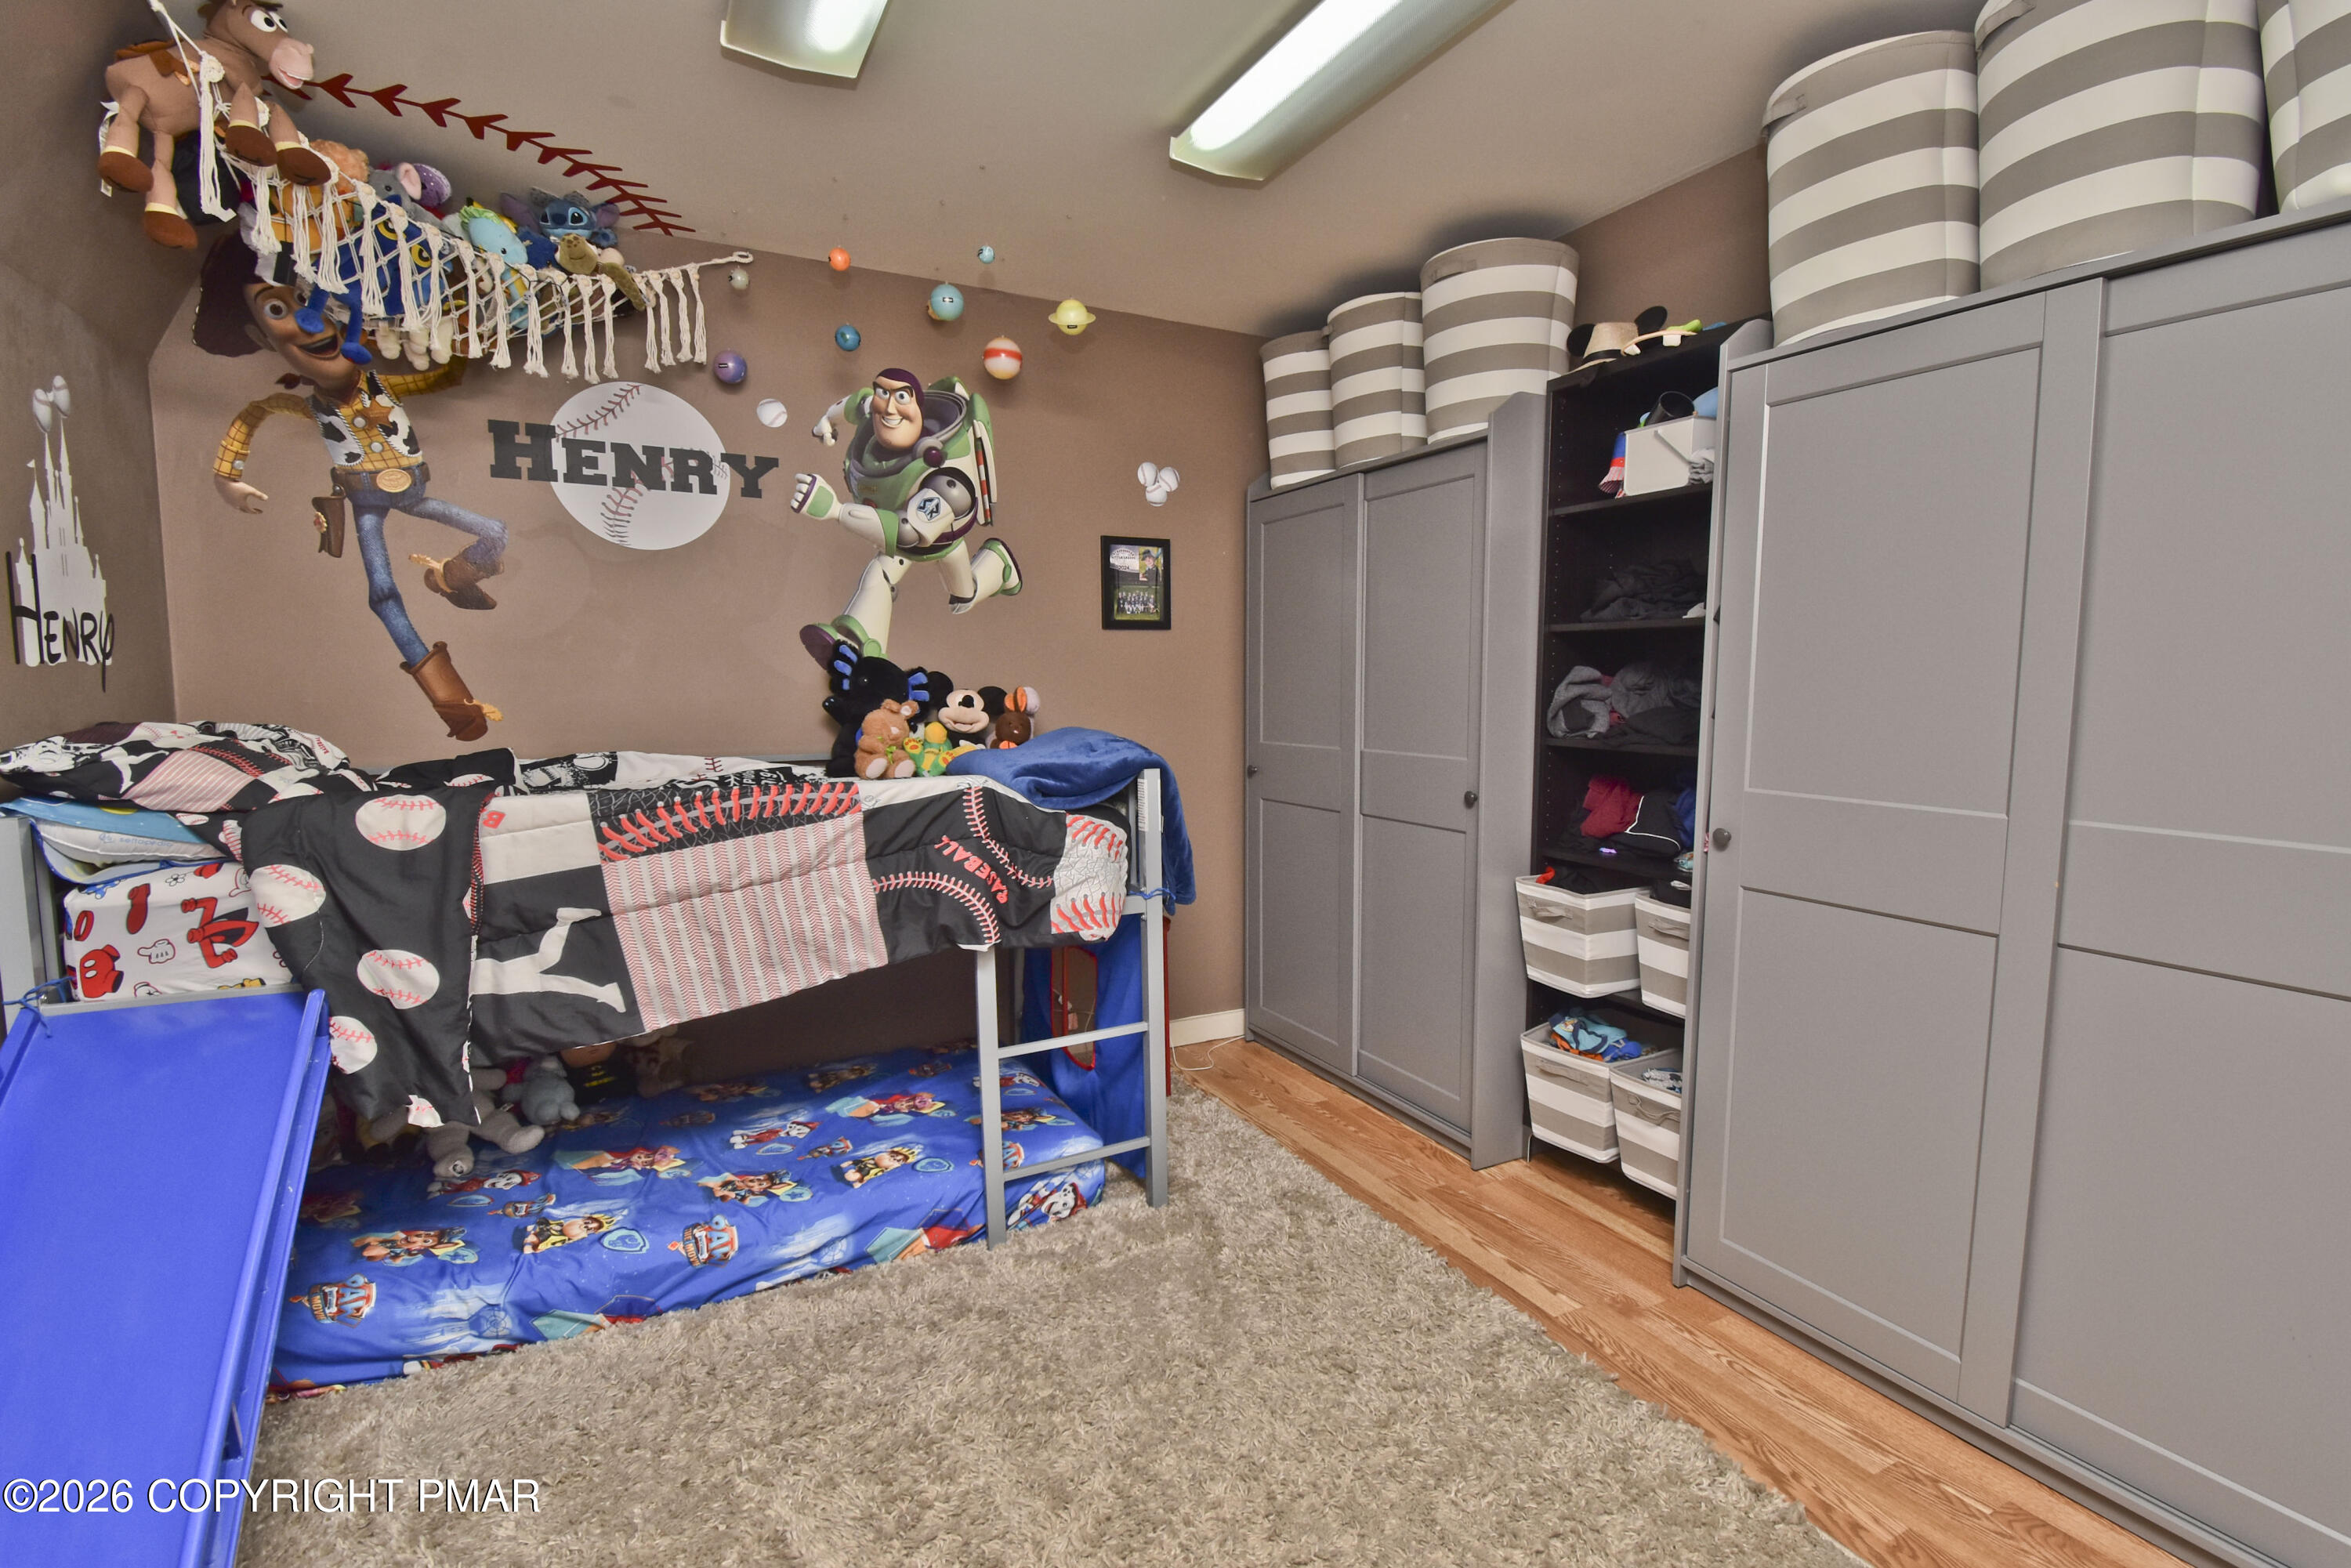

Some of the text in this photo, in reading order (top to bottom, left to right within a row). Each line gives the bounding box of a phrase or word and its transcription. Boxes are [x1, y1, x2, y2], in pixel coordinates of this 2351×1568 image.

[487, 419, 779, 498] HENRY
[5, 551, 115, 693] HENRY
[934, 835, 1009, 904] BASEBALL
